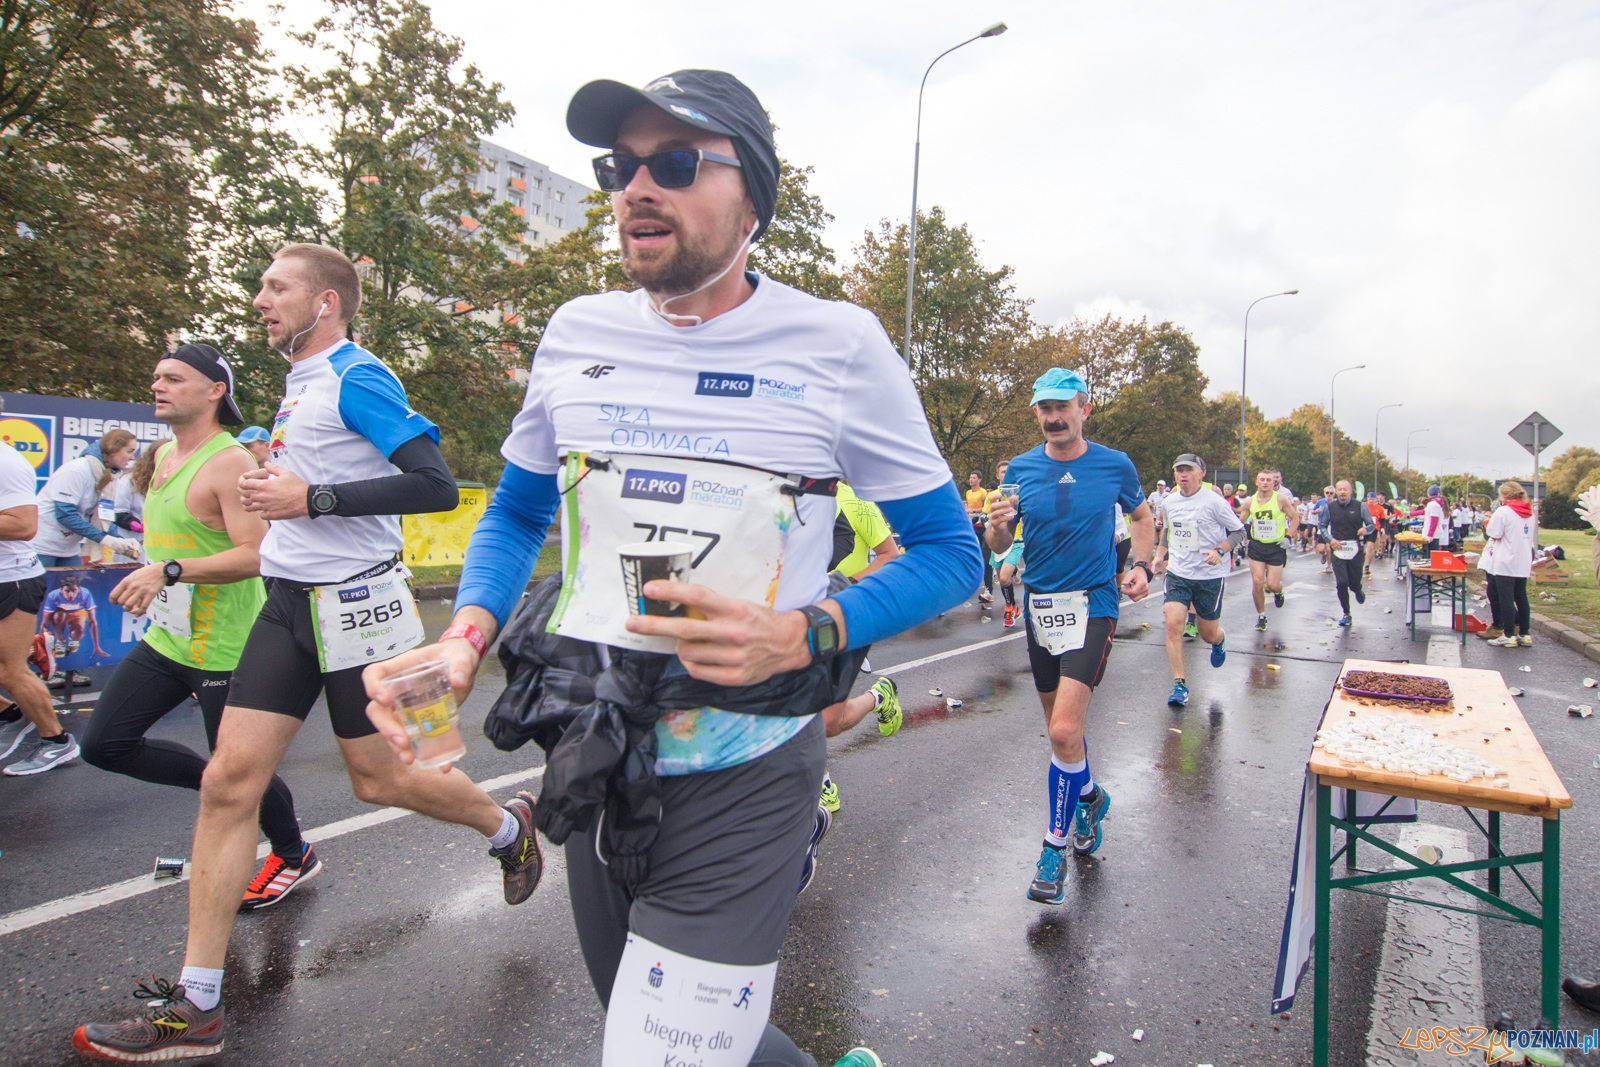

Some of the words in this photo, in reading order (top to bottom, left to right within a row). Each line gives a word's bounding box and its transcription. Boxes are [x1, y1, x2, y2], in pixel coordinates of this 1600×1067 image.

[581, 364, 616, 379] 4F
[758, 387, 805, 401] maraton
[597, 403, 651, 426] SIŁA
[611, 428, 731, 457] ODWAGA
[459, 497, 477, 505] IECI
[690, 491, 744, 507] maraton
[145, 530, 198, 549] ENICE
[1174, 530, 1192, 538] 4720
[339, 599, 404, 632] 3269
[1037, 612, 1077, 629] 1993
[189, 583, 217, 666] ZYSZTOF
[360, 626, 394, 640] Marcin
[694, 994, 719, 1005] razem
[643, 1013, 703, 1054] biegnę
[708, 1030, 733, 1051] dla
